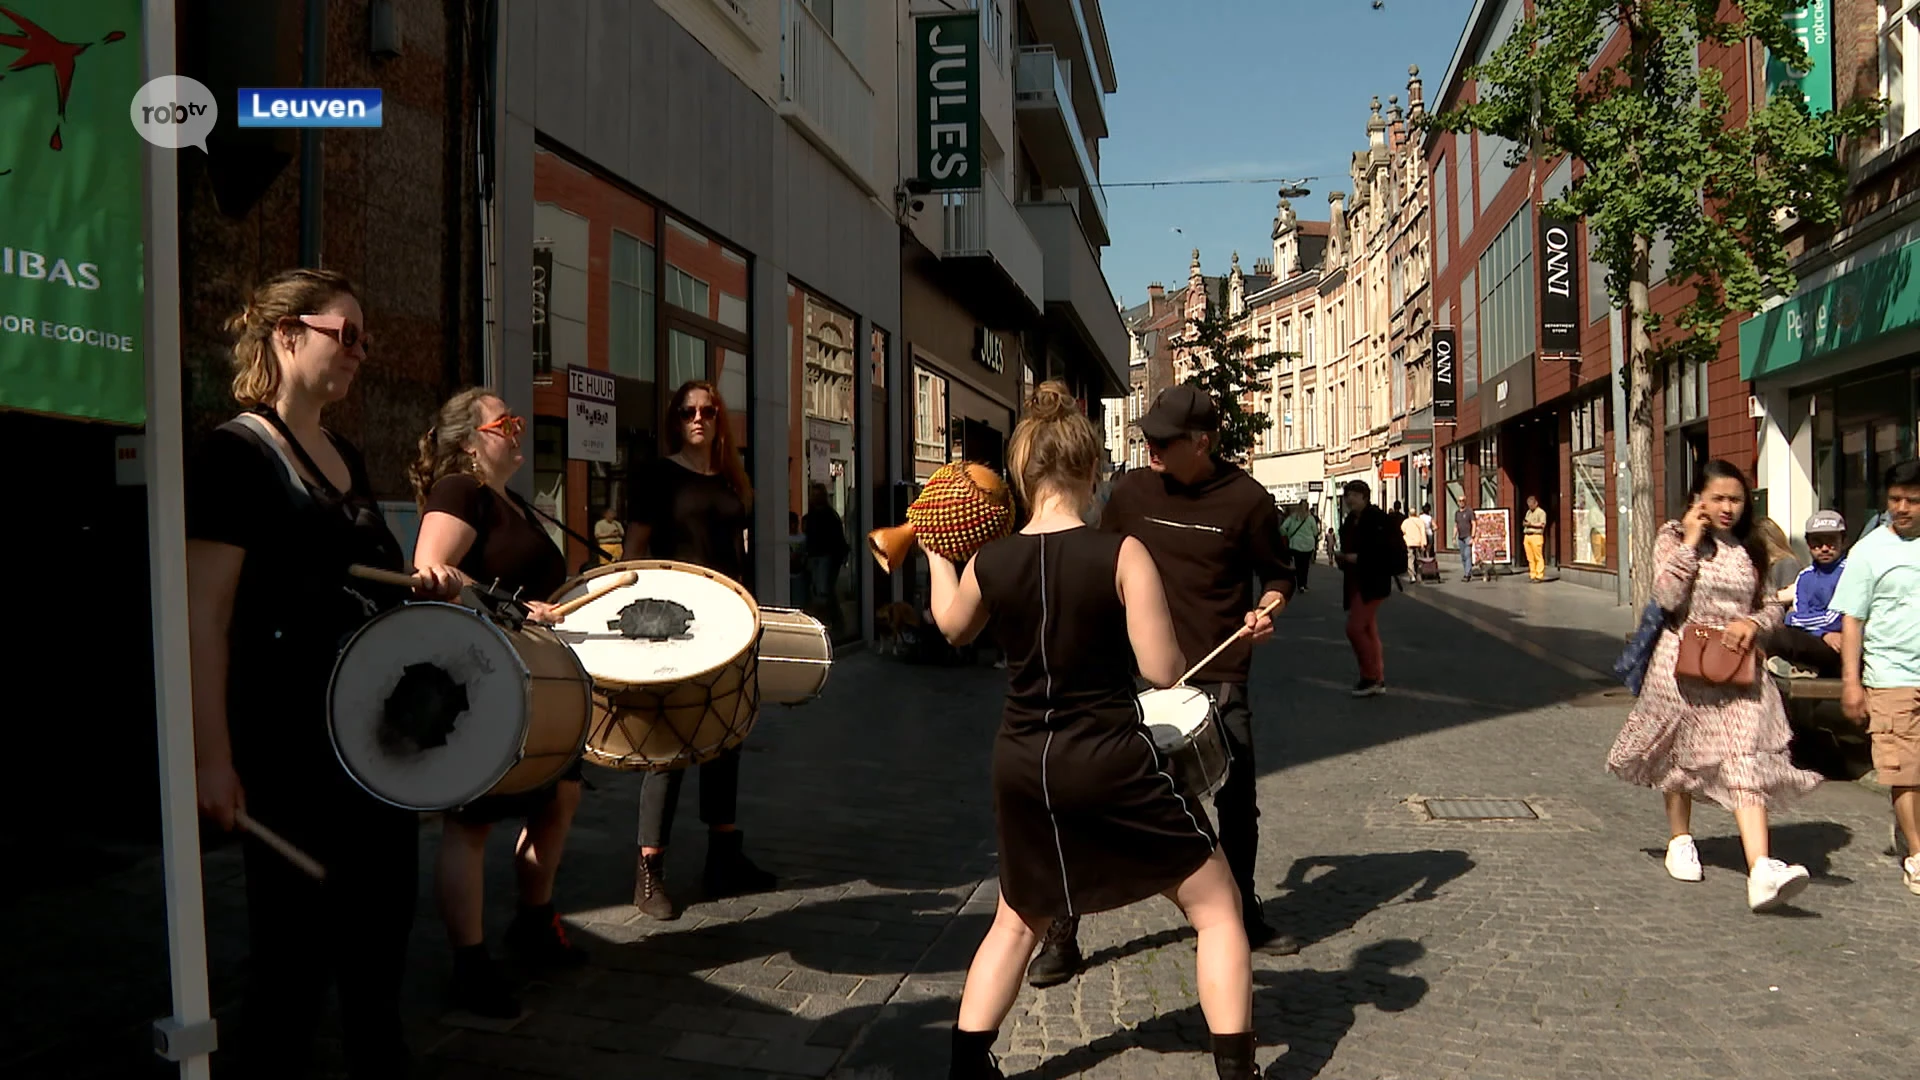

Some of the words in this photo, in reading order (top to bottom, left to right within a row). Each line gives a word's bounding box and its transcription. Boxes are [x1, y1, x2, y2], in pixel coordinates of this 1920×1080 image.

[1812, 0, 1827, 44] opticie
[928, 24, 968, 180] JULES
[1545, 227, 1571, 298] INNO
[0, 315, 36, 335] OR
[41, 320, 134, 352] ECOCIDE
[1787, 304, 1828, 342] Peae
[980, 325, 1005, 375] JULES
[1436, 340, 1452, 385] INNO
[571, 372, 584, 392] TE
[586, 378, 613, 398] HUUR
